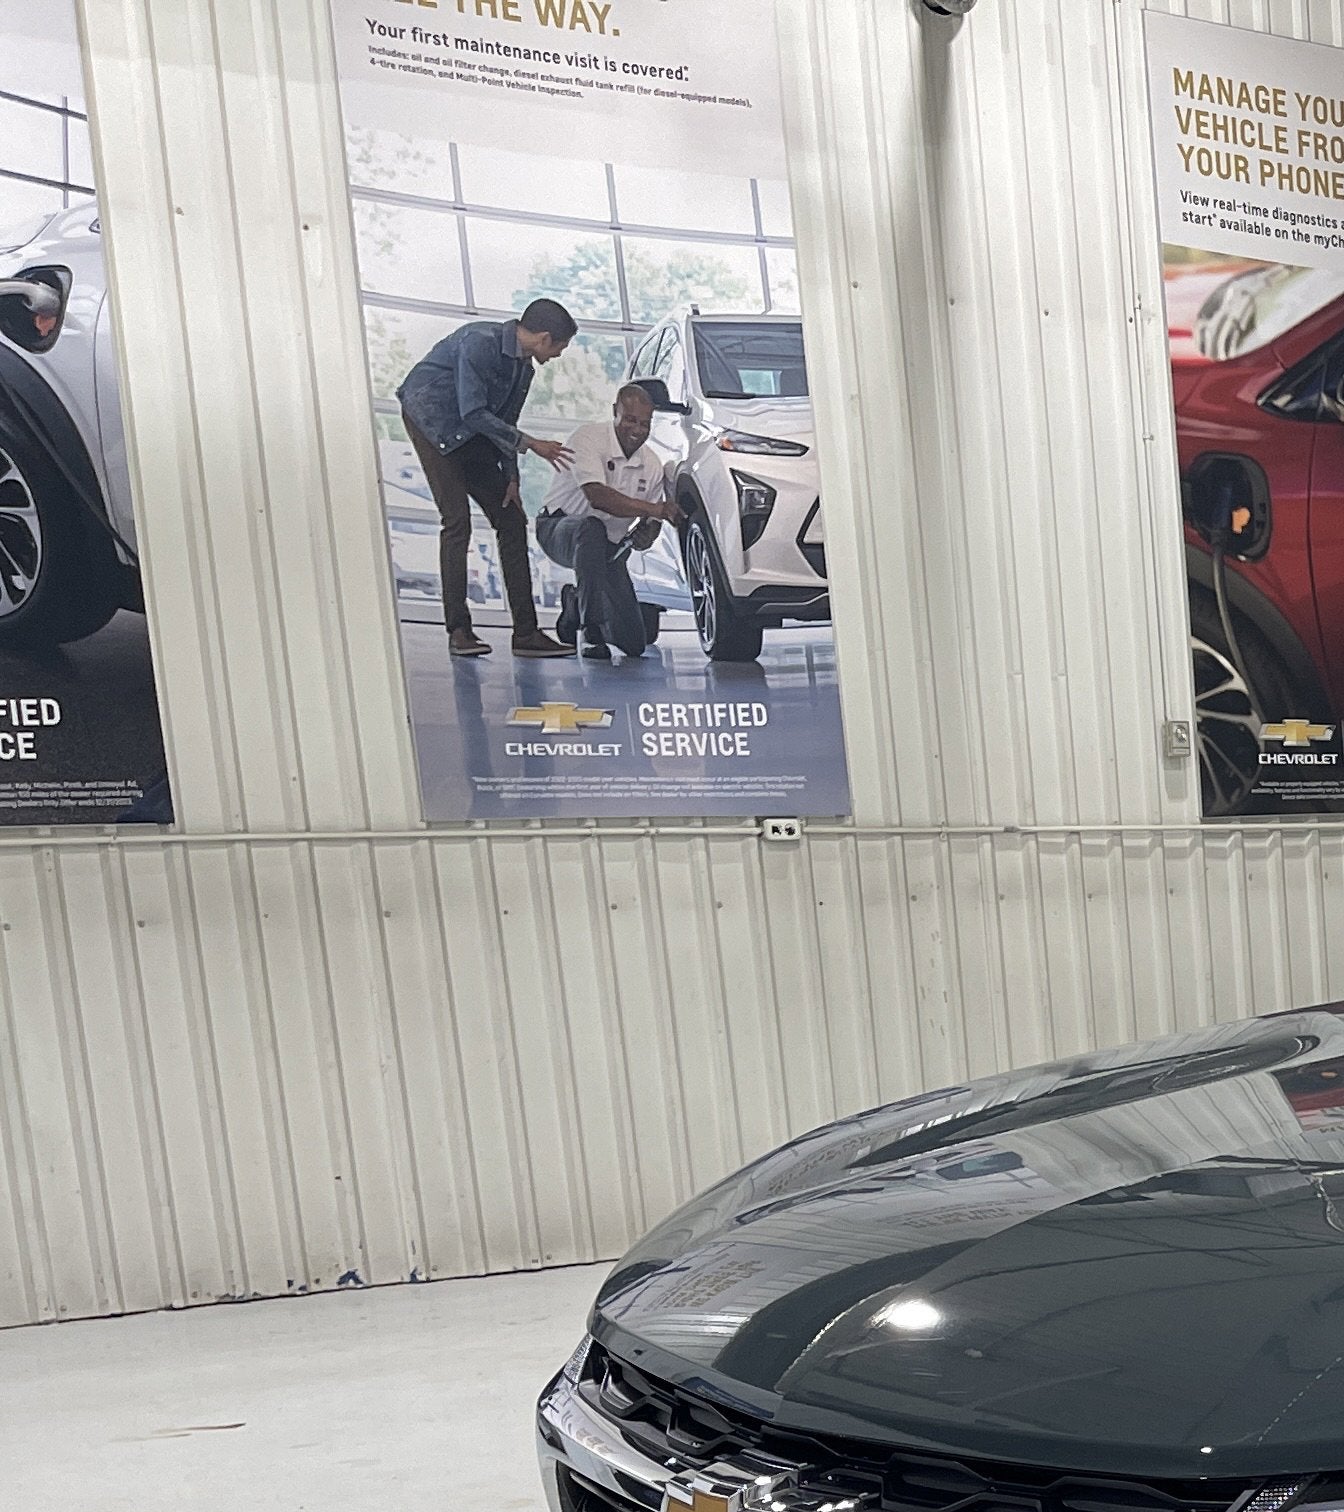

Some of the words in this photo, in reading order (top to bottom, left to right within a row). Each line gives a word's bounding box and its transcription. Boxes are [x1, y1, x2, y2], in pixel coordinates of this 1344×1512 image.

[535, 0, 620, 36] WAY.
[365, 17, 406, 39] Your
[411, 26, 450, 47] first
[454, 38, 561, 64] maintenance
[565, 52, 600, 70] visit
[604, 56, 617, 72] is
[1173, 67, 1288, 118] MANAGE
[1174, 105, 1289, 155] VEHICLE
[1176, 143, 1250, 184] YOUR
[1180, 190, 1209, 208] View
[1213, 198, 1269, 218] real-time
[1272, 207, 1338, 229] diagnostics
[1219, 219, 1271, 237] available
[1274, 228, 1289, 240] on
[1291, 228, 1311, 243] the
[638, 703, 768, 727] CERTIFIED
[505, 743, 622, 757] CHEVROLET
[642, 732, 750, 757] SERVICE
[1258, 753, 1338, 765] CHEVROLET
